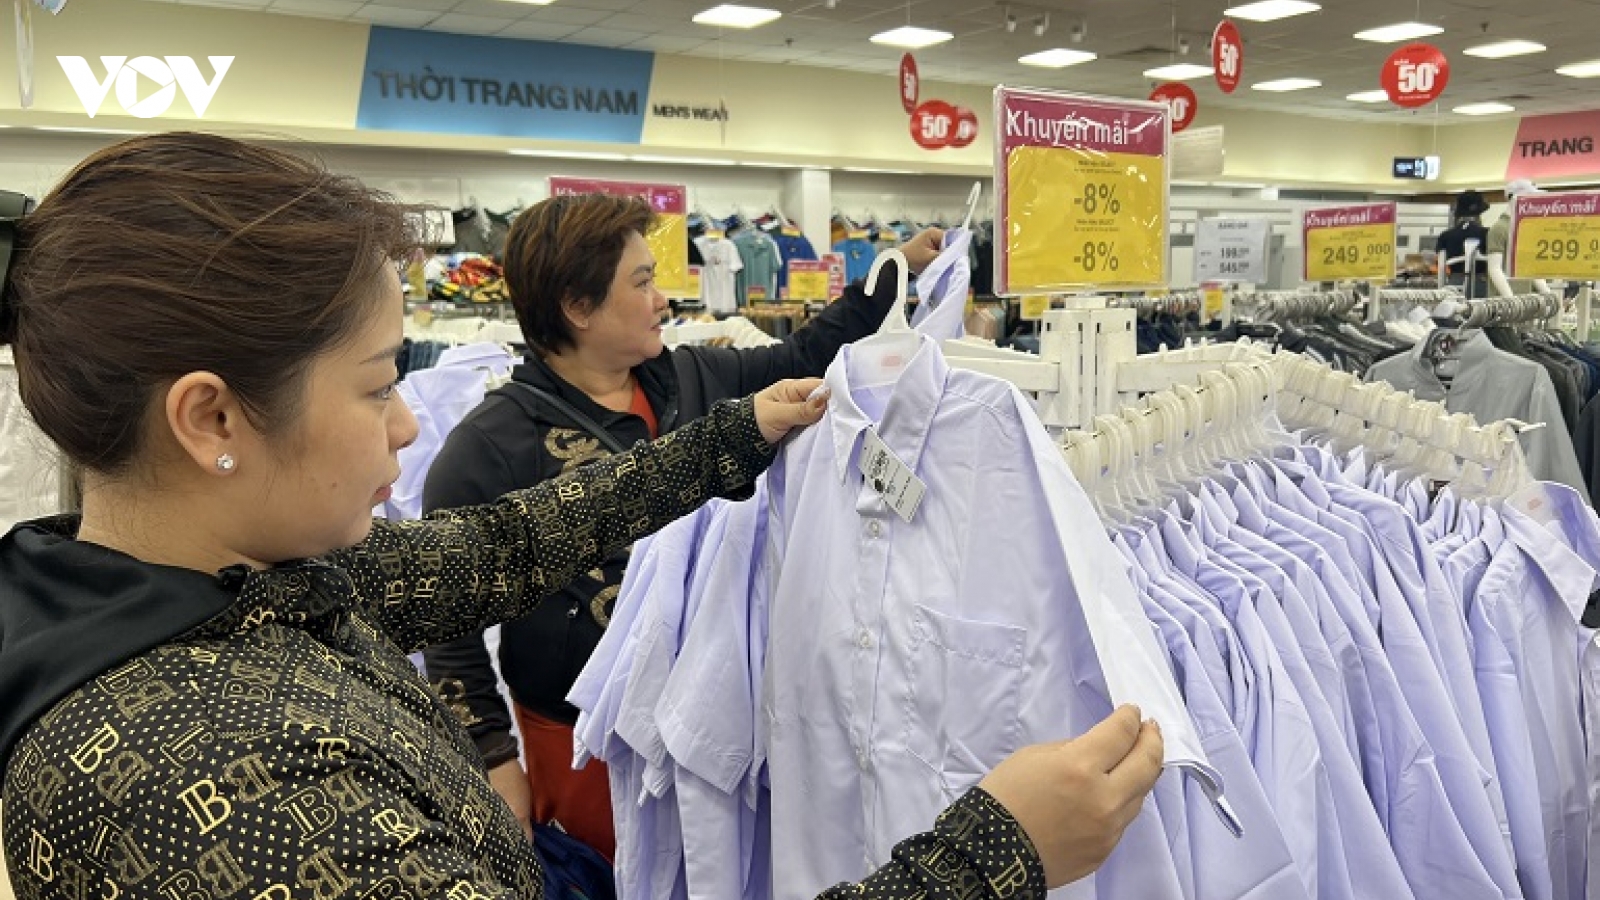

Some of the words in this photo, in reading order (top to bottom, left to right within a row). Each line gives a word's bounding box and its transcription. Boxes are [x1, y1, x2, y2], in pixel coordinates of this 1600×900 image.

[372, 65, 455, 103] THỜI
[461, 77, 568, 111] TRANG
[573, 86, 639, 116] NAM
[1005, 108, 1088, 147] Khuyến
[1094, 119, 1129, 145] mãi
[1519, 136, 1593, 157] TRANG
[1074, 183, 1121, 215] -8%
[1073, 241, 1119, 272] -8%
[1323, 246, 1360, 265] 249
[1366, 243, 1391, 255] 000
[1536, 239, 1580, 261] 299
